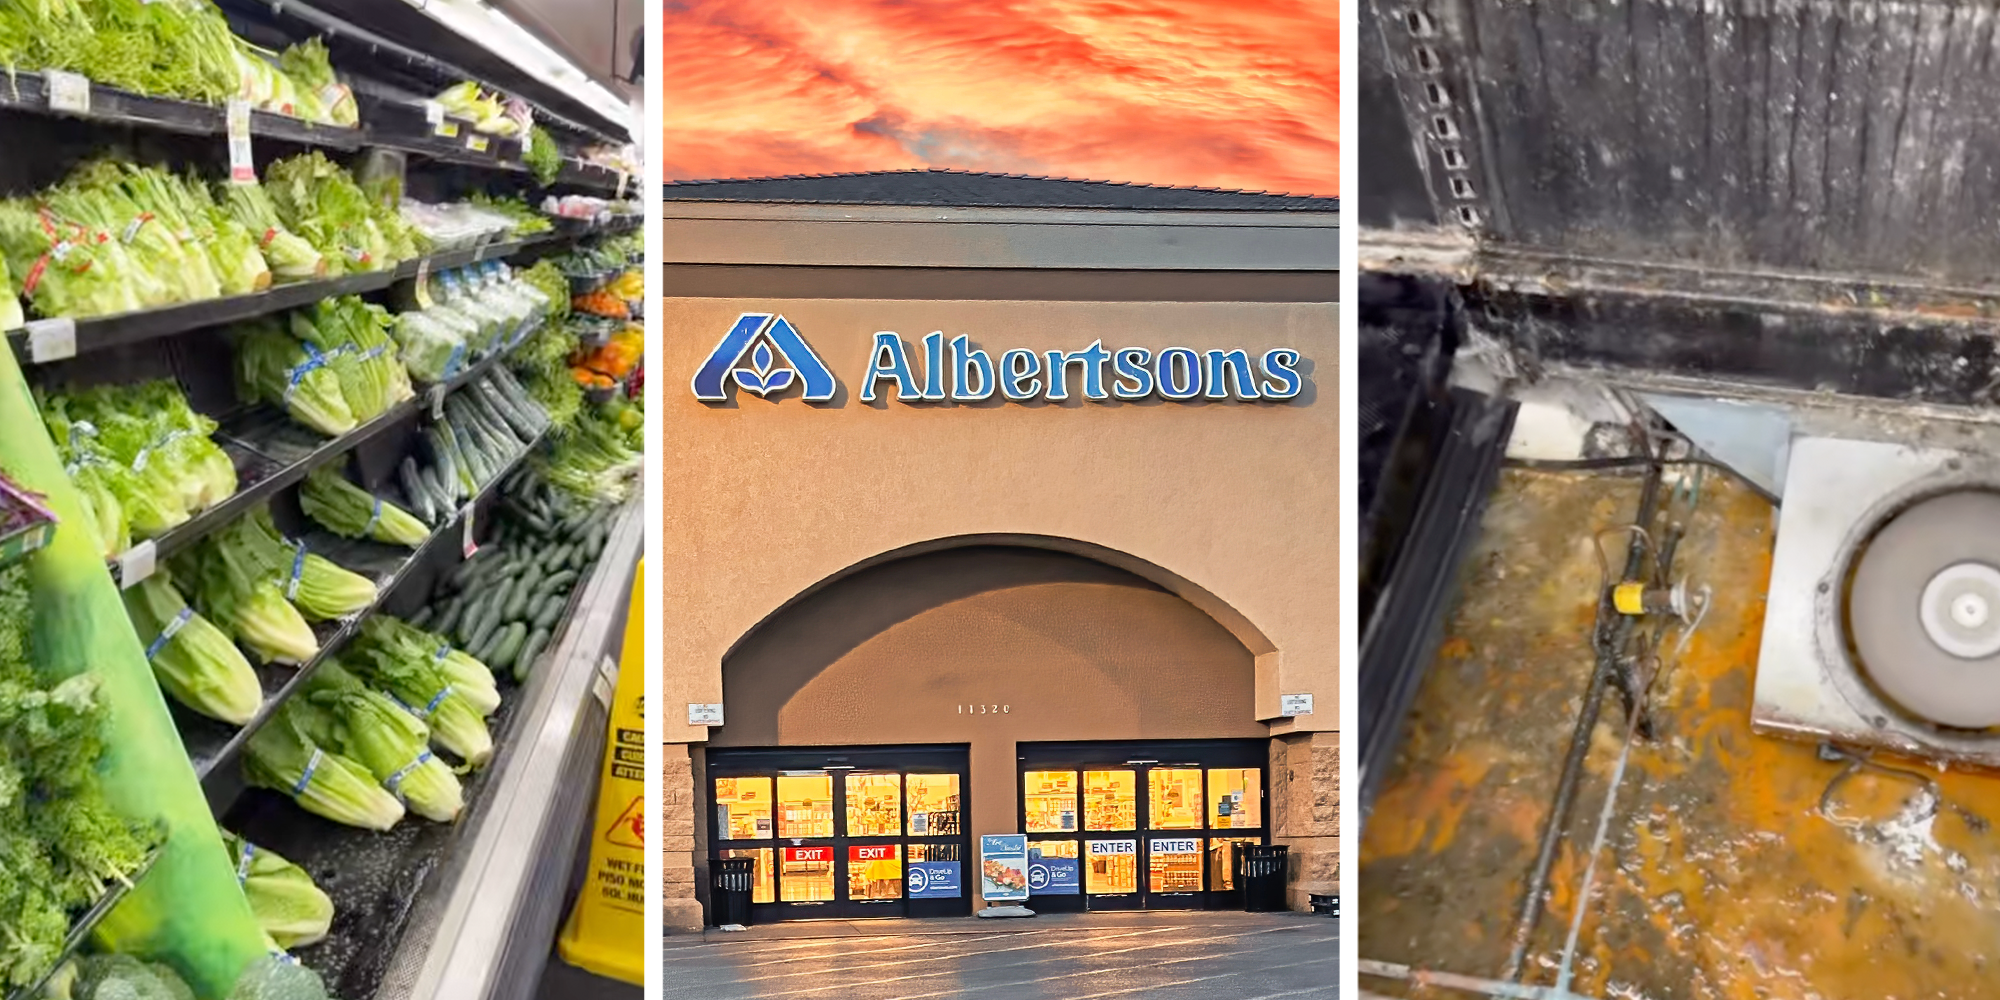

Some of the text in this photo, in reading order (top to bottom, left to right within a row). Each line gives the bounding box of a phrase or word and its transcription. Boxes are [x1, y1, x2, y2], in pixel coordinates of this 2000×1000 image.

[860, 330, 1303, 402] Albertsons
[958, 704, 1010, 714] 11320
[1092, 842, 1133, 853] ENTER
[1153, 841, 1194, 852] ENTER
[796, 849, 823, 860] EXIT
[858, 847, 886, 858] EXIT
[607, 857, 631, 872] WET
[598, 870, 625, 886] PISO
